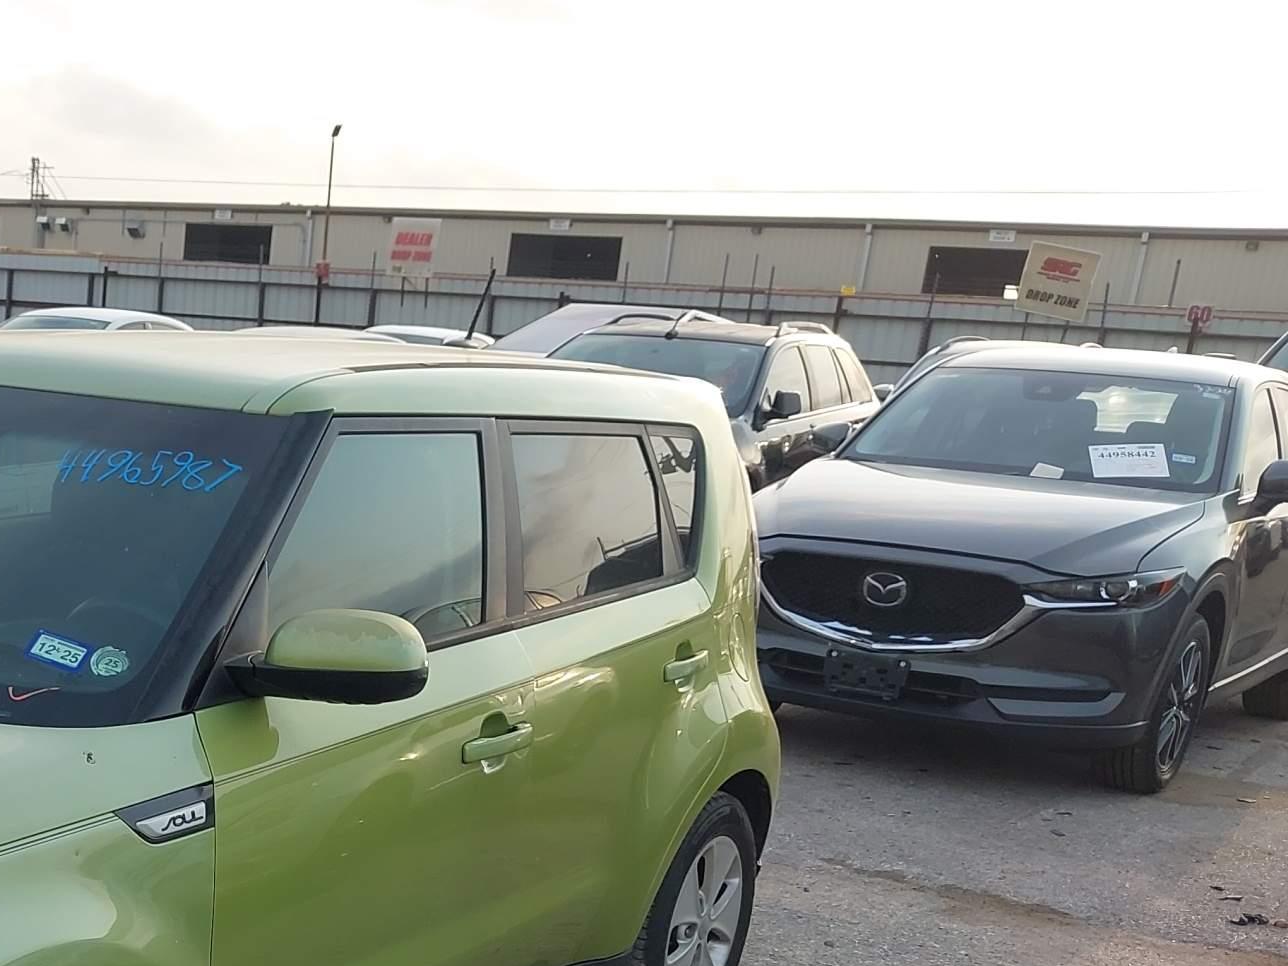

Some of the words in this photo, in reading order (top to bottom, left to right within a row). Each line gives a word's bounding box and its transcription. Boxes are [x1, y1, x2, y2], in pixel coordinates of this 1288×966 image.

[1025, 289, 1054, 304] DROP
[1054, 294, 1081, 309] ZONE
[1187, 305, 1212, 324] 60
[1098, 450, 1157, 459] 44958442
[56, 449, 242, 492] 44965987
[104, 658, 120, 669] 25
[161, 810, 204, 832] SOUL
